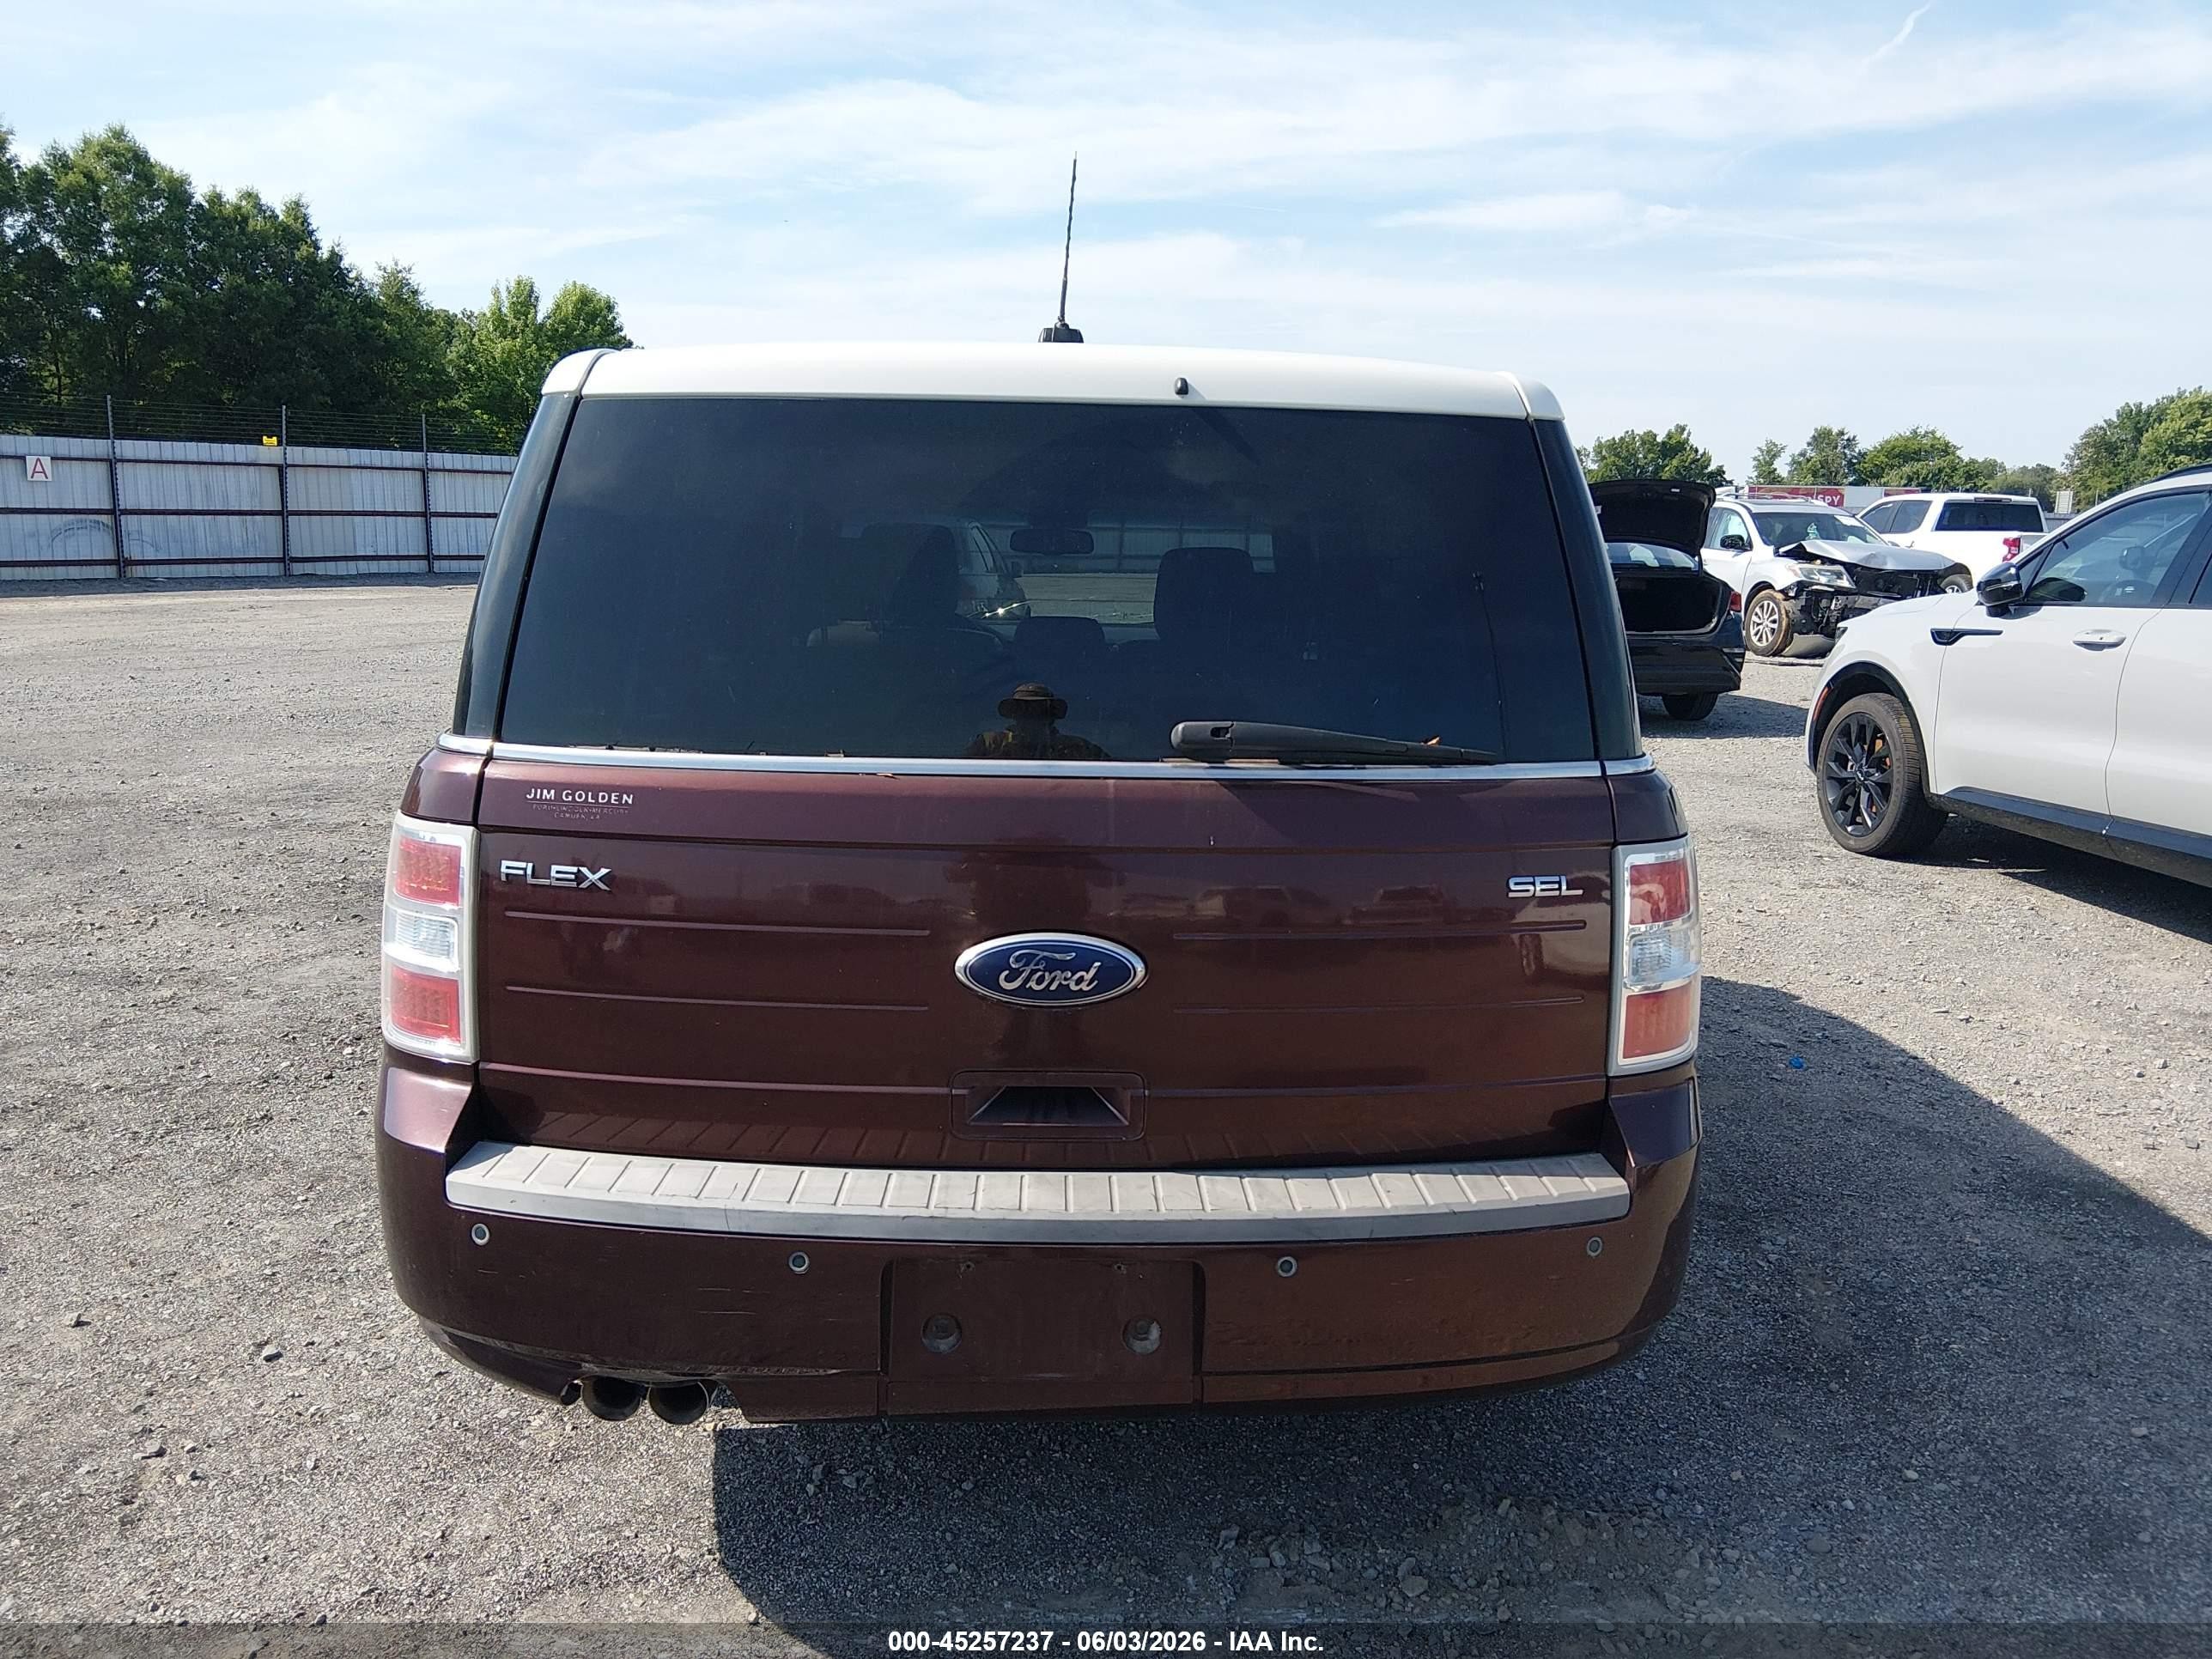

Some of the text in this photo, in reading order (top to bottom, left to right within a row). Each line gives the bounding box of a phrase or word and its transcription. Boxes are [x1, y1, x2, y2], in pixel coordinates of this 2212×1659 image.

[30, 458, 49, 479] A
[526, 788, 633, 805] JIM GOLDEN
[501, 860, 612, 891] FLEX
[1508, 875, 1584, 897] SEL
[999, 949, 1102, 991] Ford
